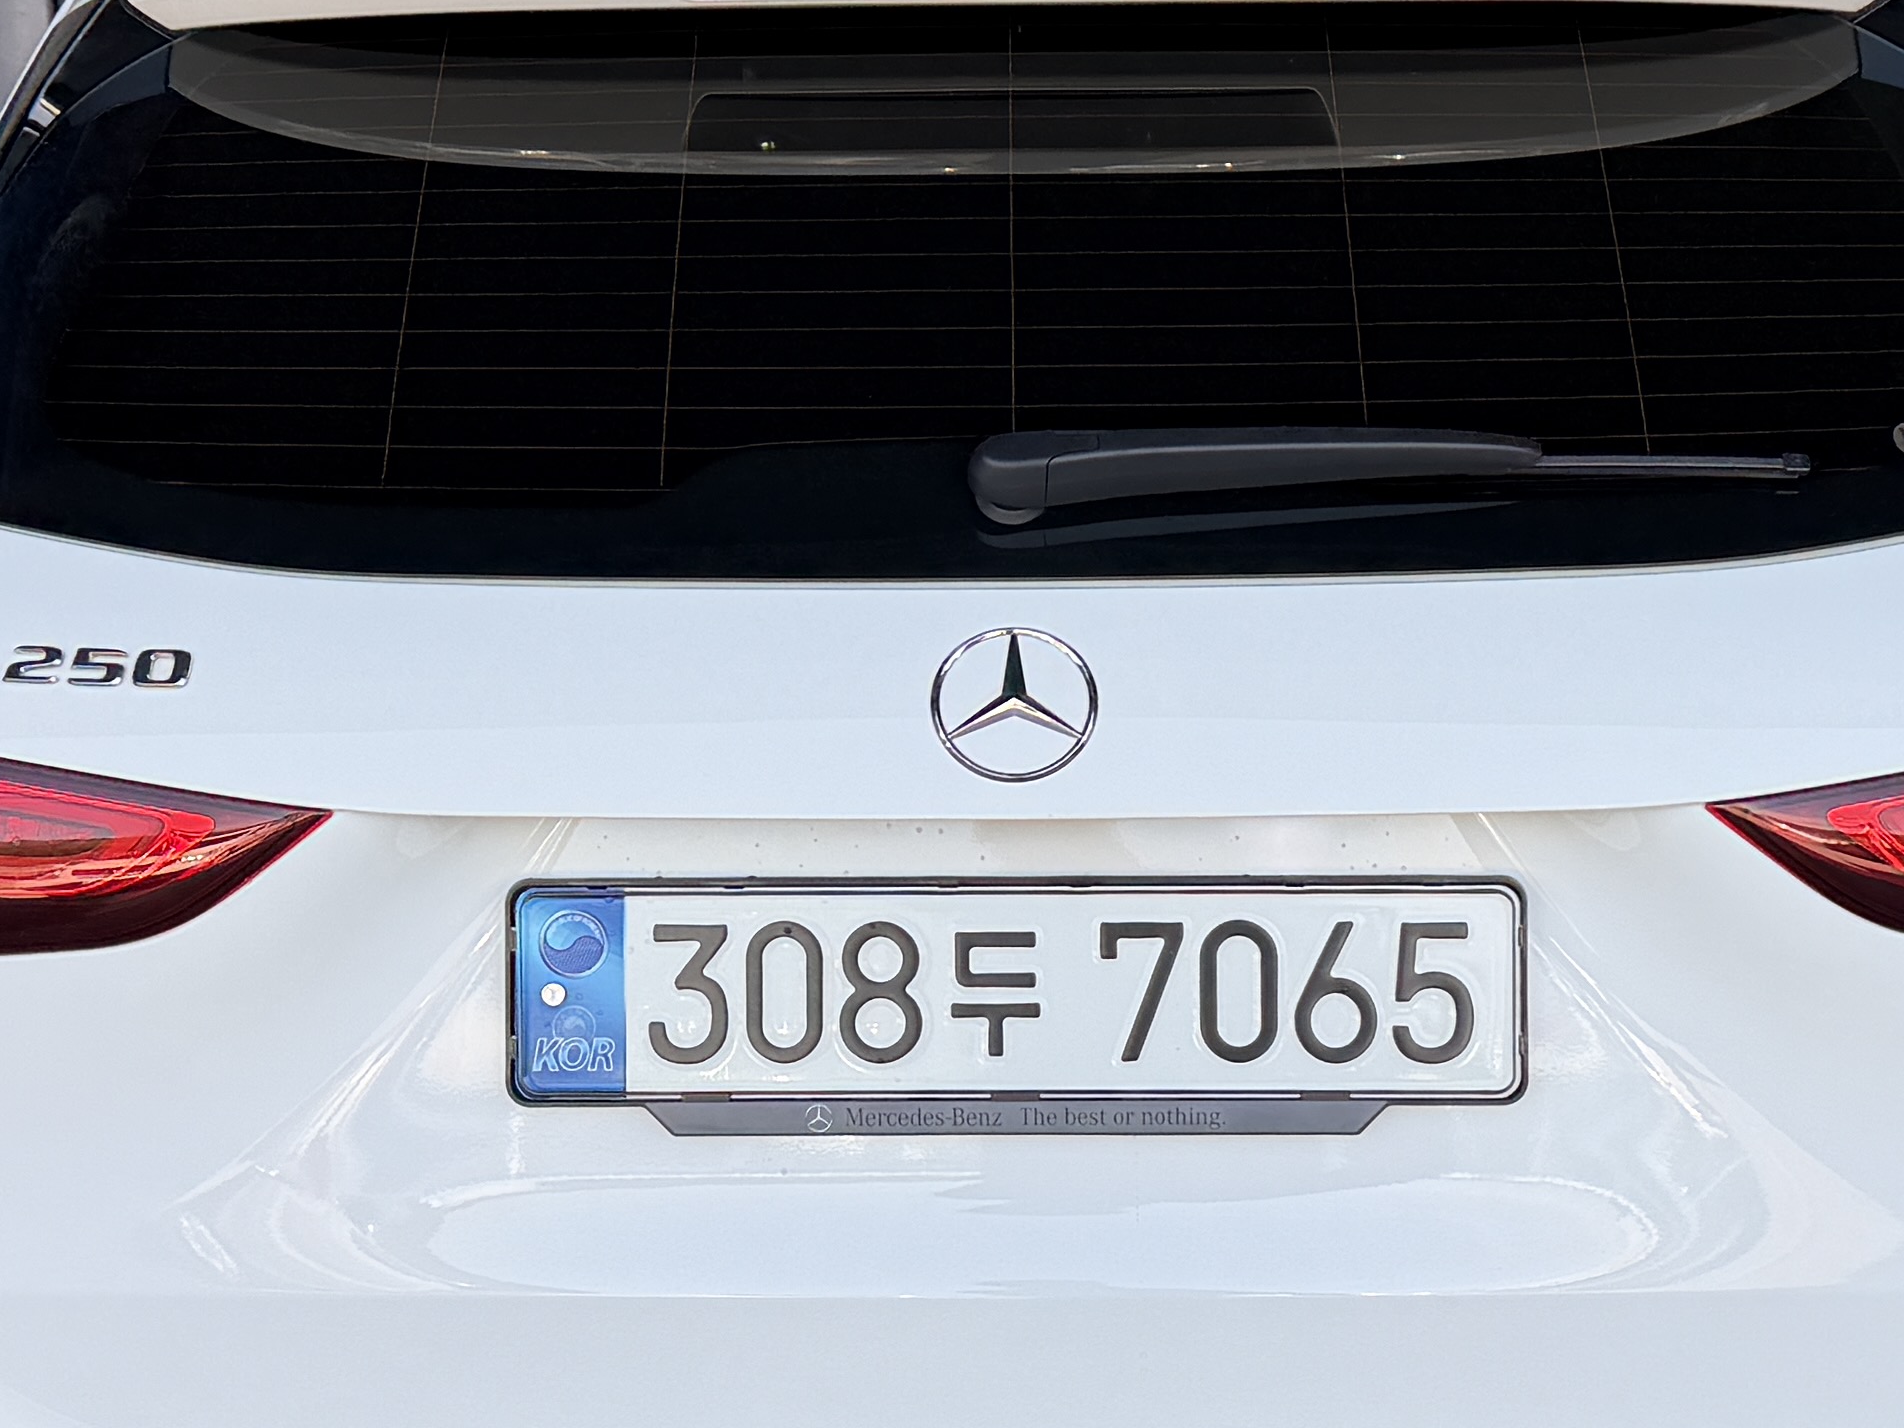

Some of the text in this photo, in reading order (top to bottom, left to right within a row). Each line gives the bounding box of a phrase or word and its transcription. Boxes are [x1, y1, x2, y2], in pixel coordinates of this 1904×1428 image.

[2, 644, 194, 688] 250
[647, 919, 1475, 1064] 308두 7065
[532, 1037, 616, 1072] KOR
[846, 1106, 1226, 1129] Mercedes-Benz The best or nothing.
